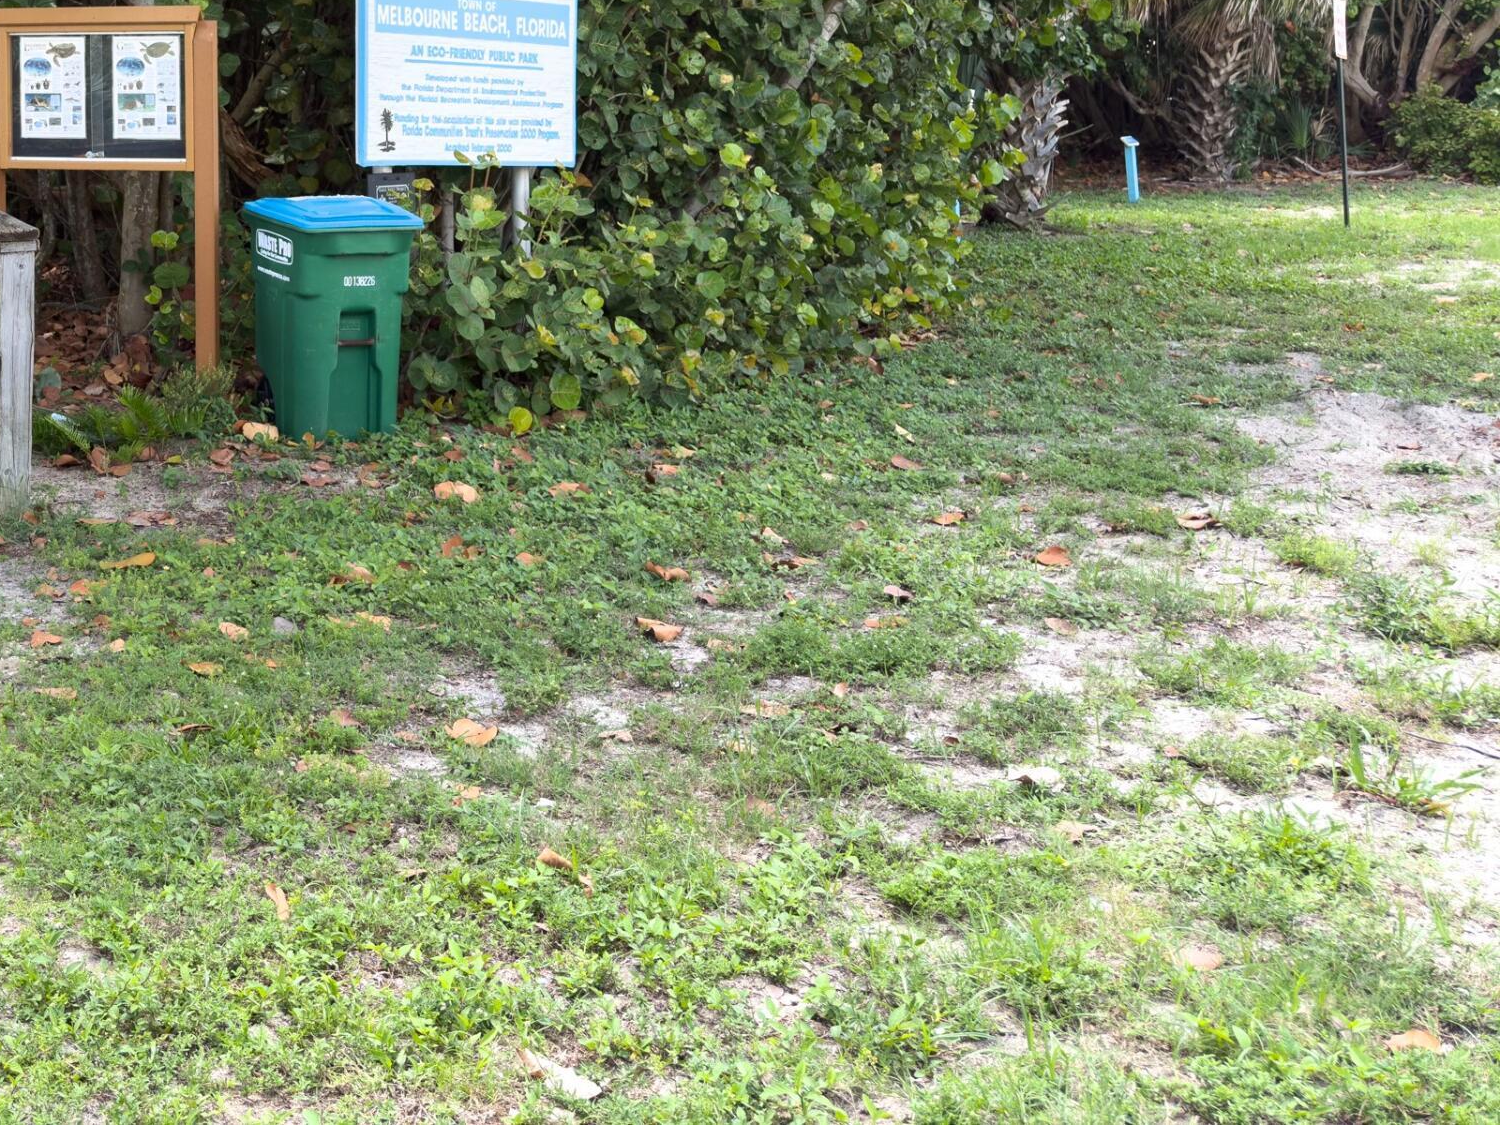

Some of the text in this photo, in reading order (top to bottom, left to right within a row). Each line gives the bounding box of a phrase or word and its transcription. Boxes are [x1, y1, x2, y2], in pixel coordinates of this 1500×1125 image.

[485, 0, 496, 12] OF
[377, 4, 567, 39] MELBOURNE BEACH, FLORIDA
[410, 45, 538, 64] AN ECO-FRIENDLY PUBLIC PARK
[258, 231, 278, 253] WASTE
[278, 237, 292, 258] PRO
